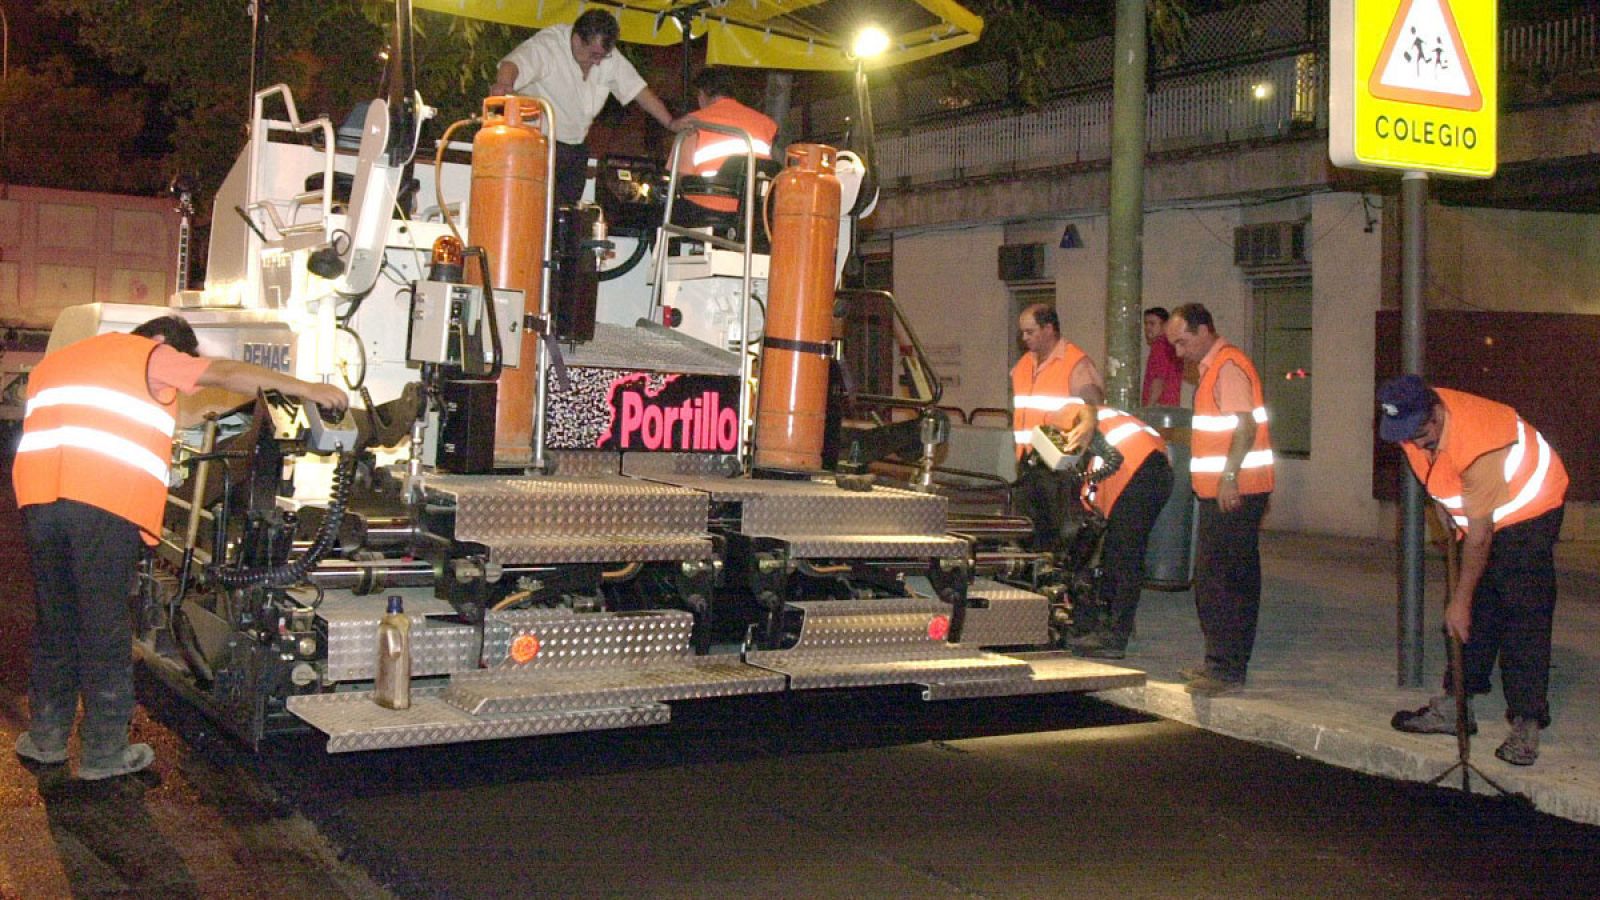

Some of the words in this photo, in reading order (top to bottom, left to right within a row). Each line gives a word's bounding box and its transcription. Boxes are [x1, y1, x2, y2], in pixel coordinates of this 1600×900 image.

[1375, 115, 1477, 149] COLEGIO
[243, 344, 290, 373] DEMAG
[620, 391, 738, 451] Portillo
